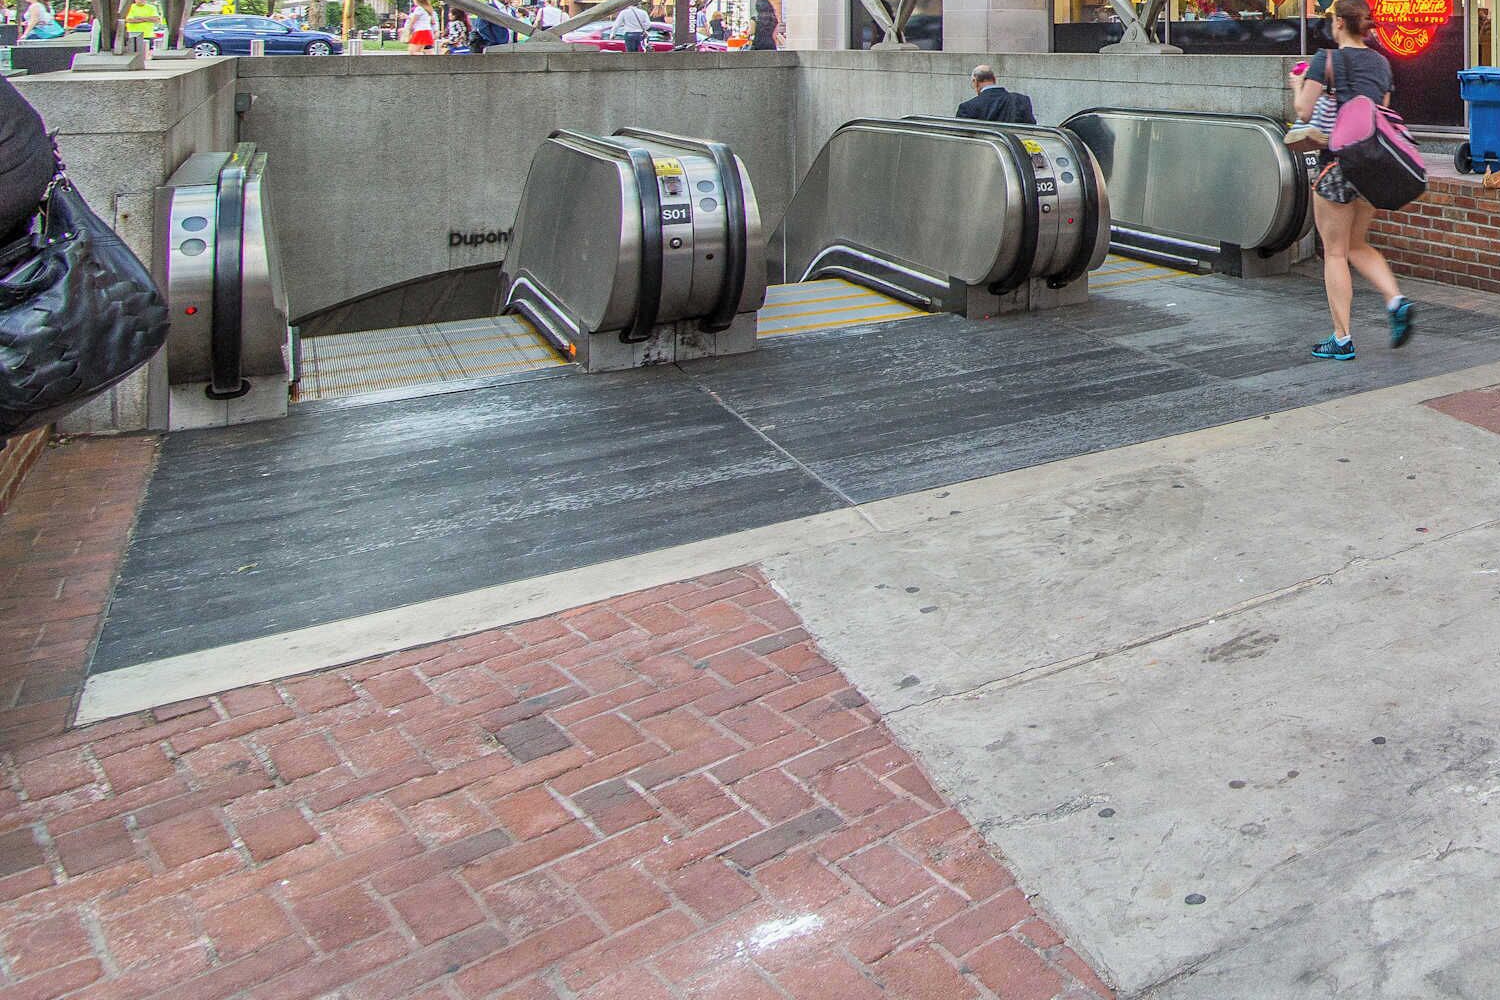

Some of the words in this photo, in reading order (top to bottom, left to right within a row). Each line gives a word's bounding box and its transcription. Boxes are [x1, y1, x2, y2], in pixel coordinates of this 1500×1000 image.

[689, 7, 698, 33] Station
[1391, 29, 1429, 51] NOW
[662, 208, 686, 221] S01
